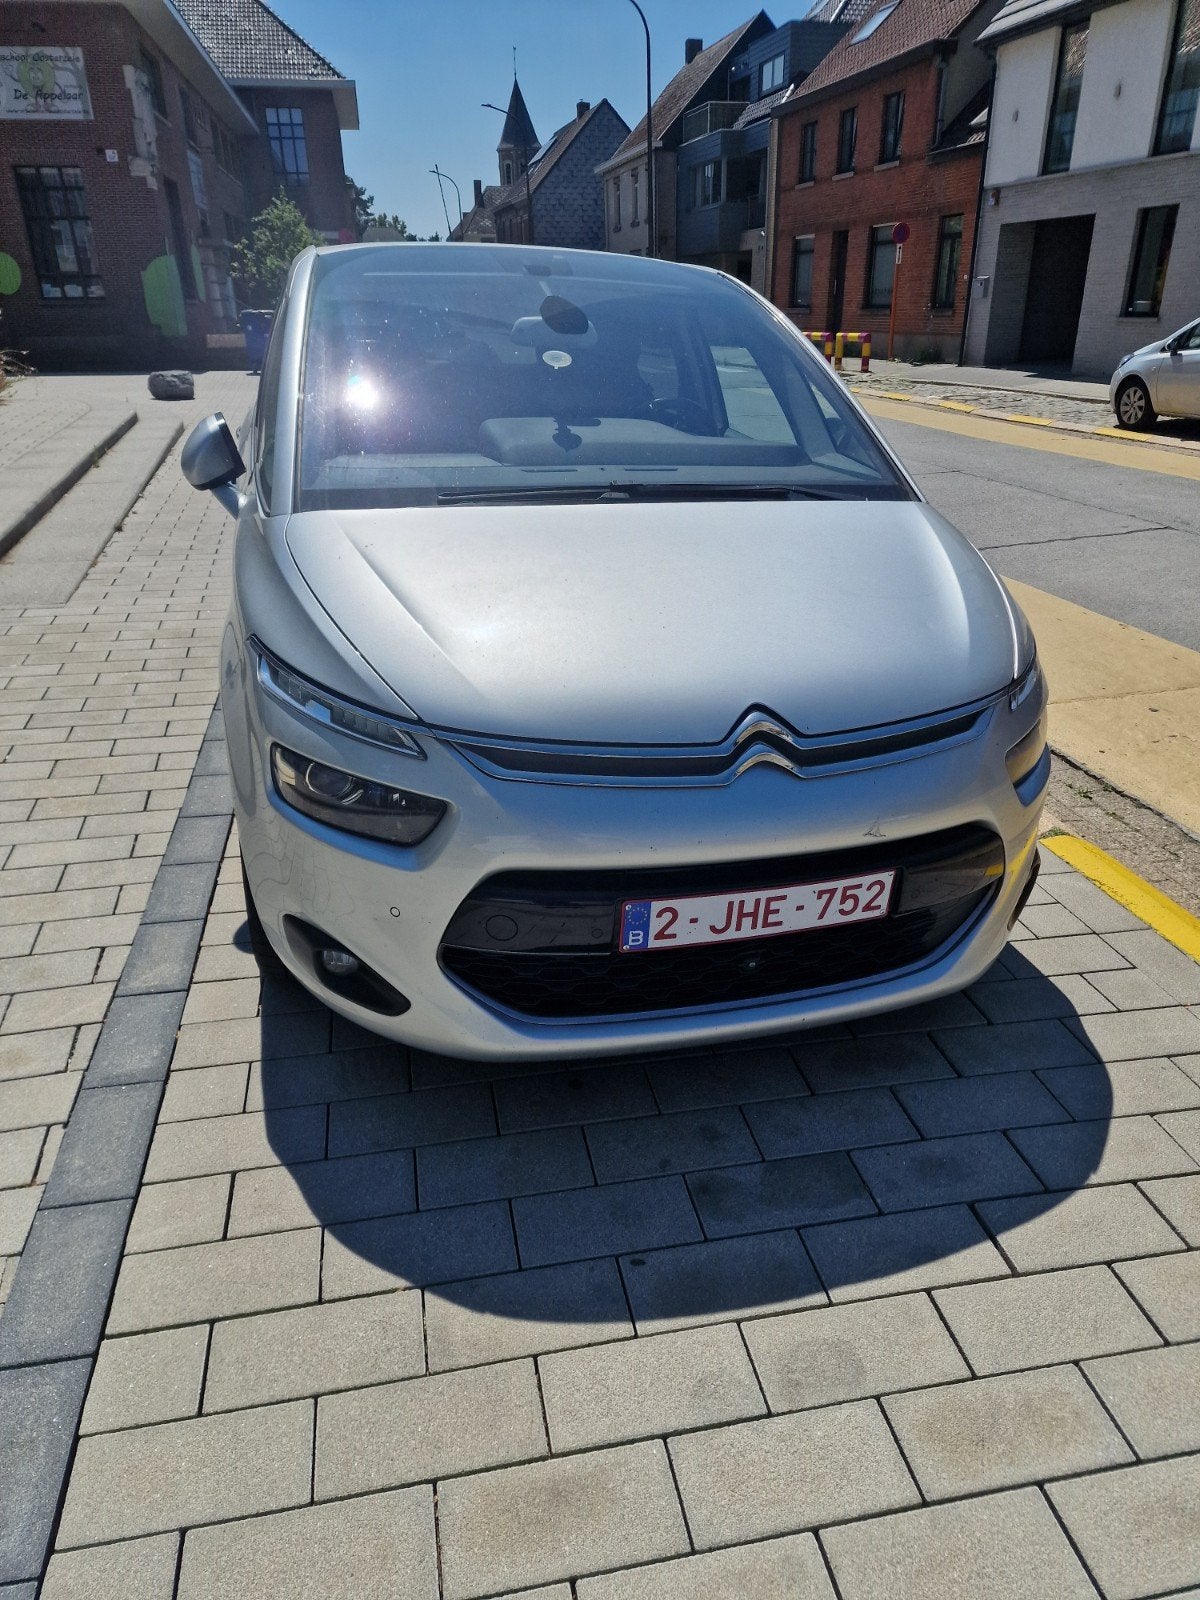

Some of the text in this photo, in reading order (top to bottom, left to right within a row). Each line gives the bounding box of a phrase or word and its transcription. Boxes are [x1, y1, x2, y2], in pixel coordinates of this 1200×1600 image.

[13, 88, 84, 103] De Appelaar
[628, 930, 644, 946] B
